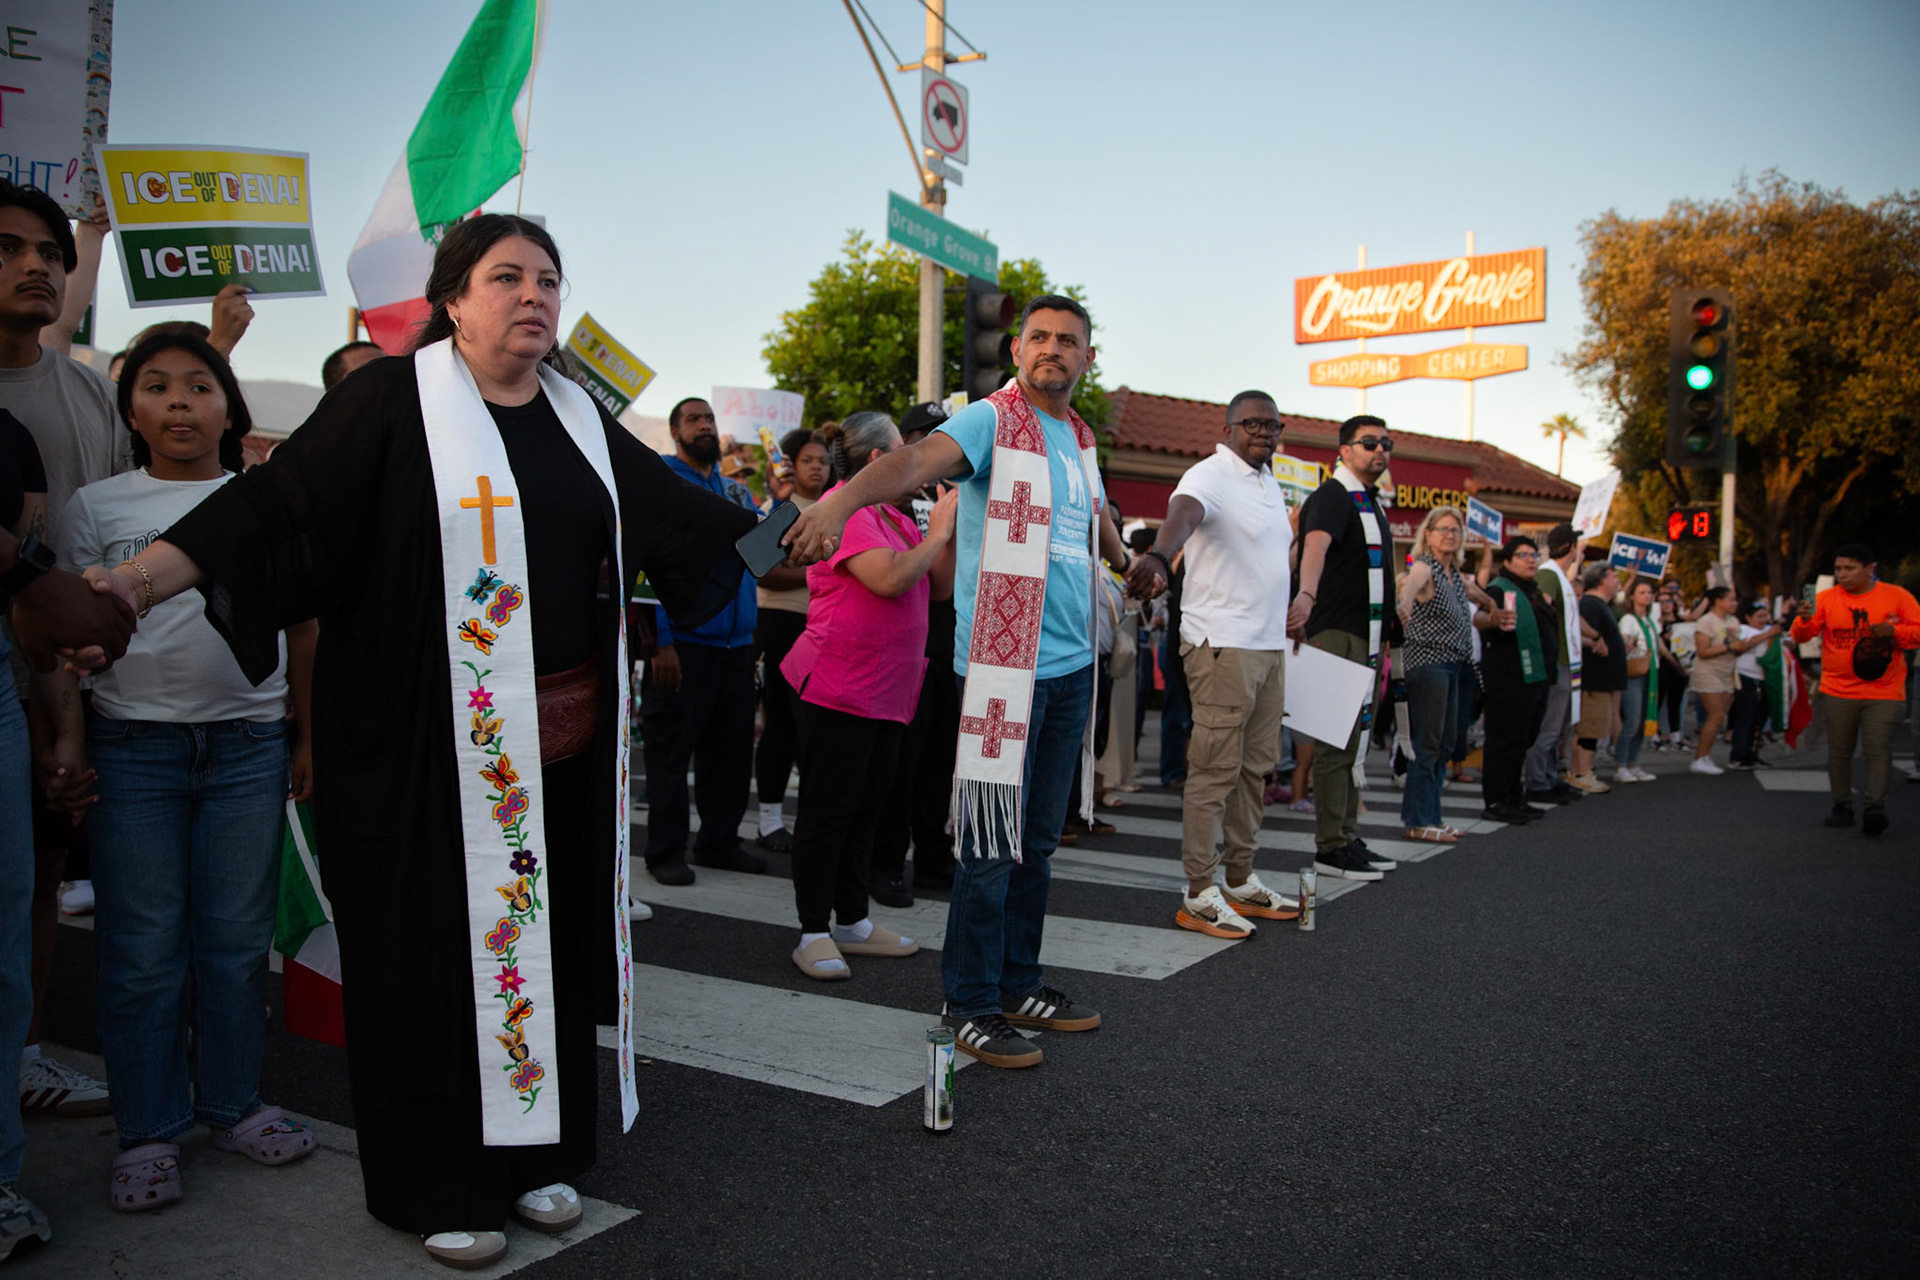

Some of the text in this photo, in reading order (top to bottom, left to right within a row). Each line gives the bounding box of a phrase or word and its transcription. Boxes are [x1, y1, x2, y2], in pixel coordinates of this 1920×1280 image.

[121, 170, 300, 205] ICE OUT OF DENA!
[890, 208, 939, 249] Orange
[944, 234, 980, 267] Grove
[140, 244, 311, 279] ICE OUT OF DENA!
[1301, 258, 1534, 336] Orange Grove
[1315, 348, 1506, 382] SHOPPING CENTER
[1397, 484, 1469, 513] BURGERS
